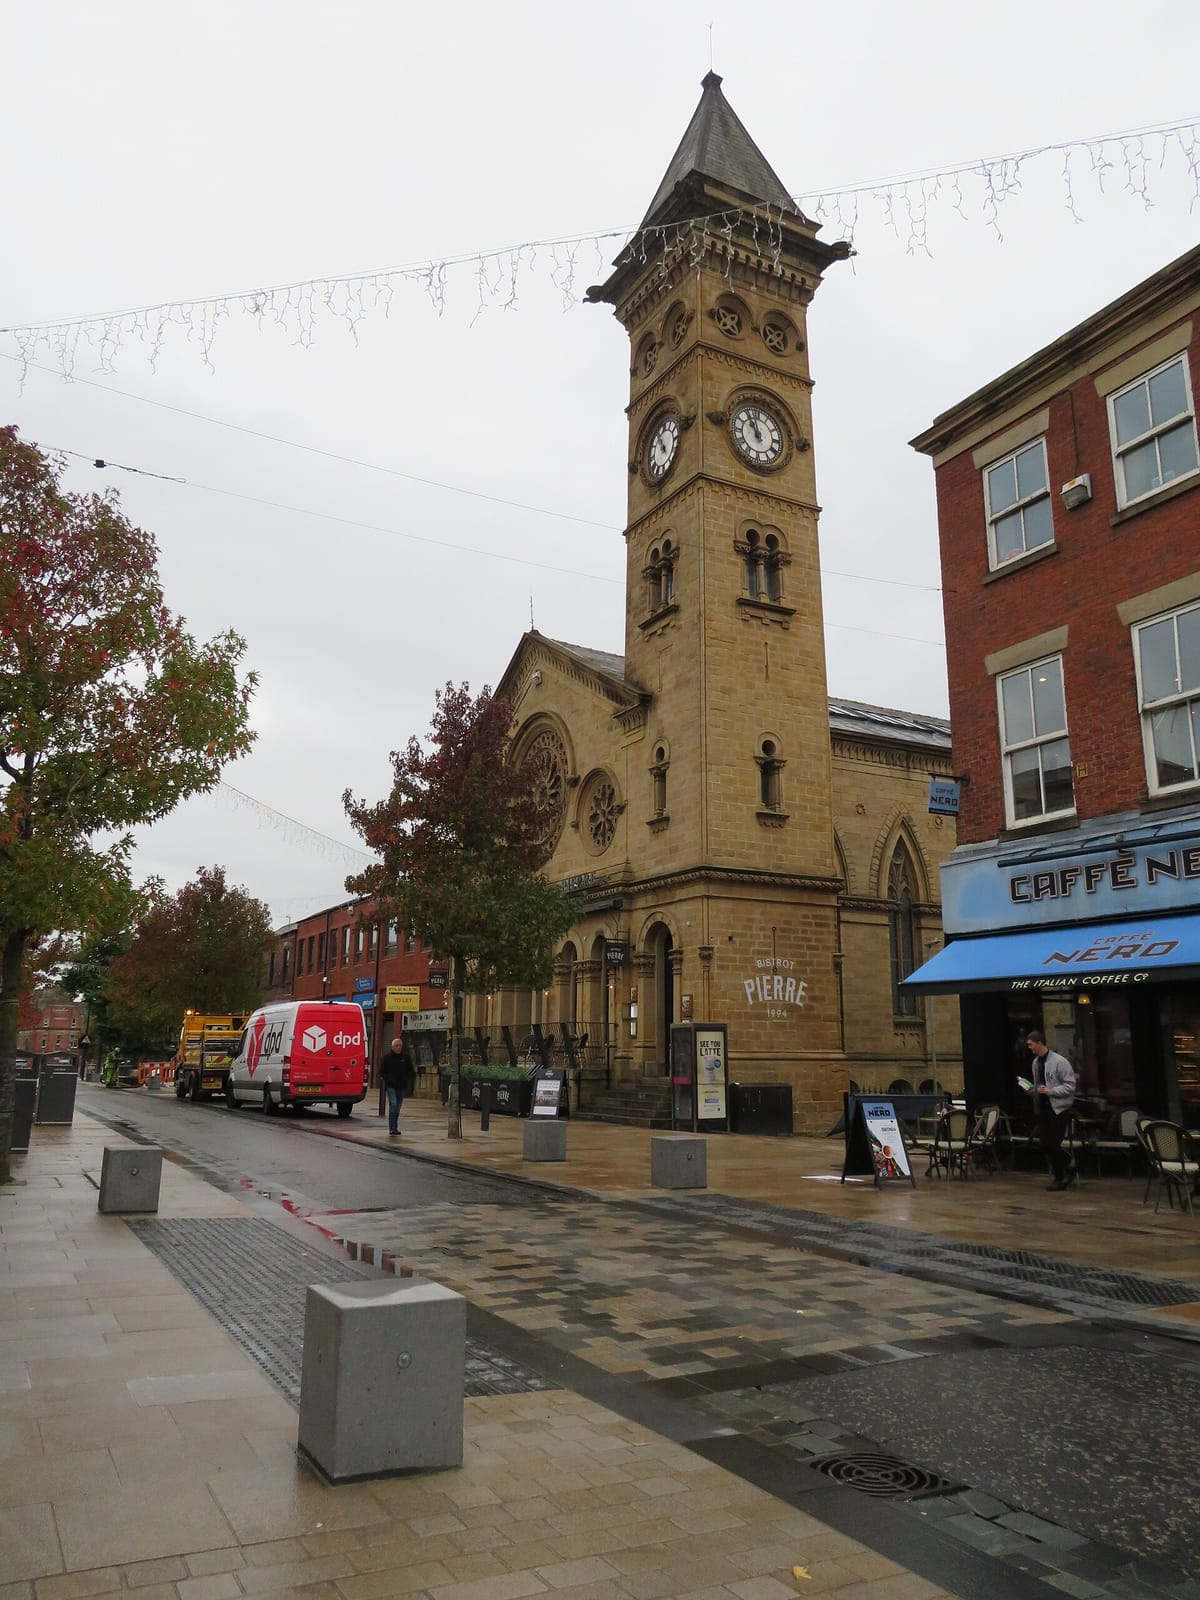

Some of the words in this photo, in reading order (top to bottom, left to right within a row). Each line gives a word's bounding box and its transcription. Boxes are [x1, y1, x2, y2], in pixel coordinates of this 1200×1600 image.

[930, 796, 958, 806] NERO
[1042, 941, 1180, 965] NERO
[757, 958, 795, 969] BISTROT
[1011, 980, 1030, 989] THE
[1033, 978, 1077, 987] ITALIAN
[1082, 974, 1130, 985] COFFEE
[744, 975, 808, 1007] PIERRE
[767, 1009, 787, 1018] 1994
[264, 1022, 286, 1060] dpd
[333, 1031, 361, 1049] dpd
[700, 1048, 720, 1056] LATTE
